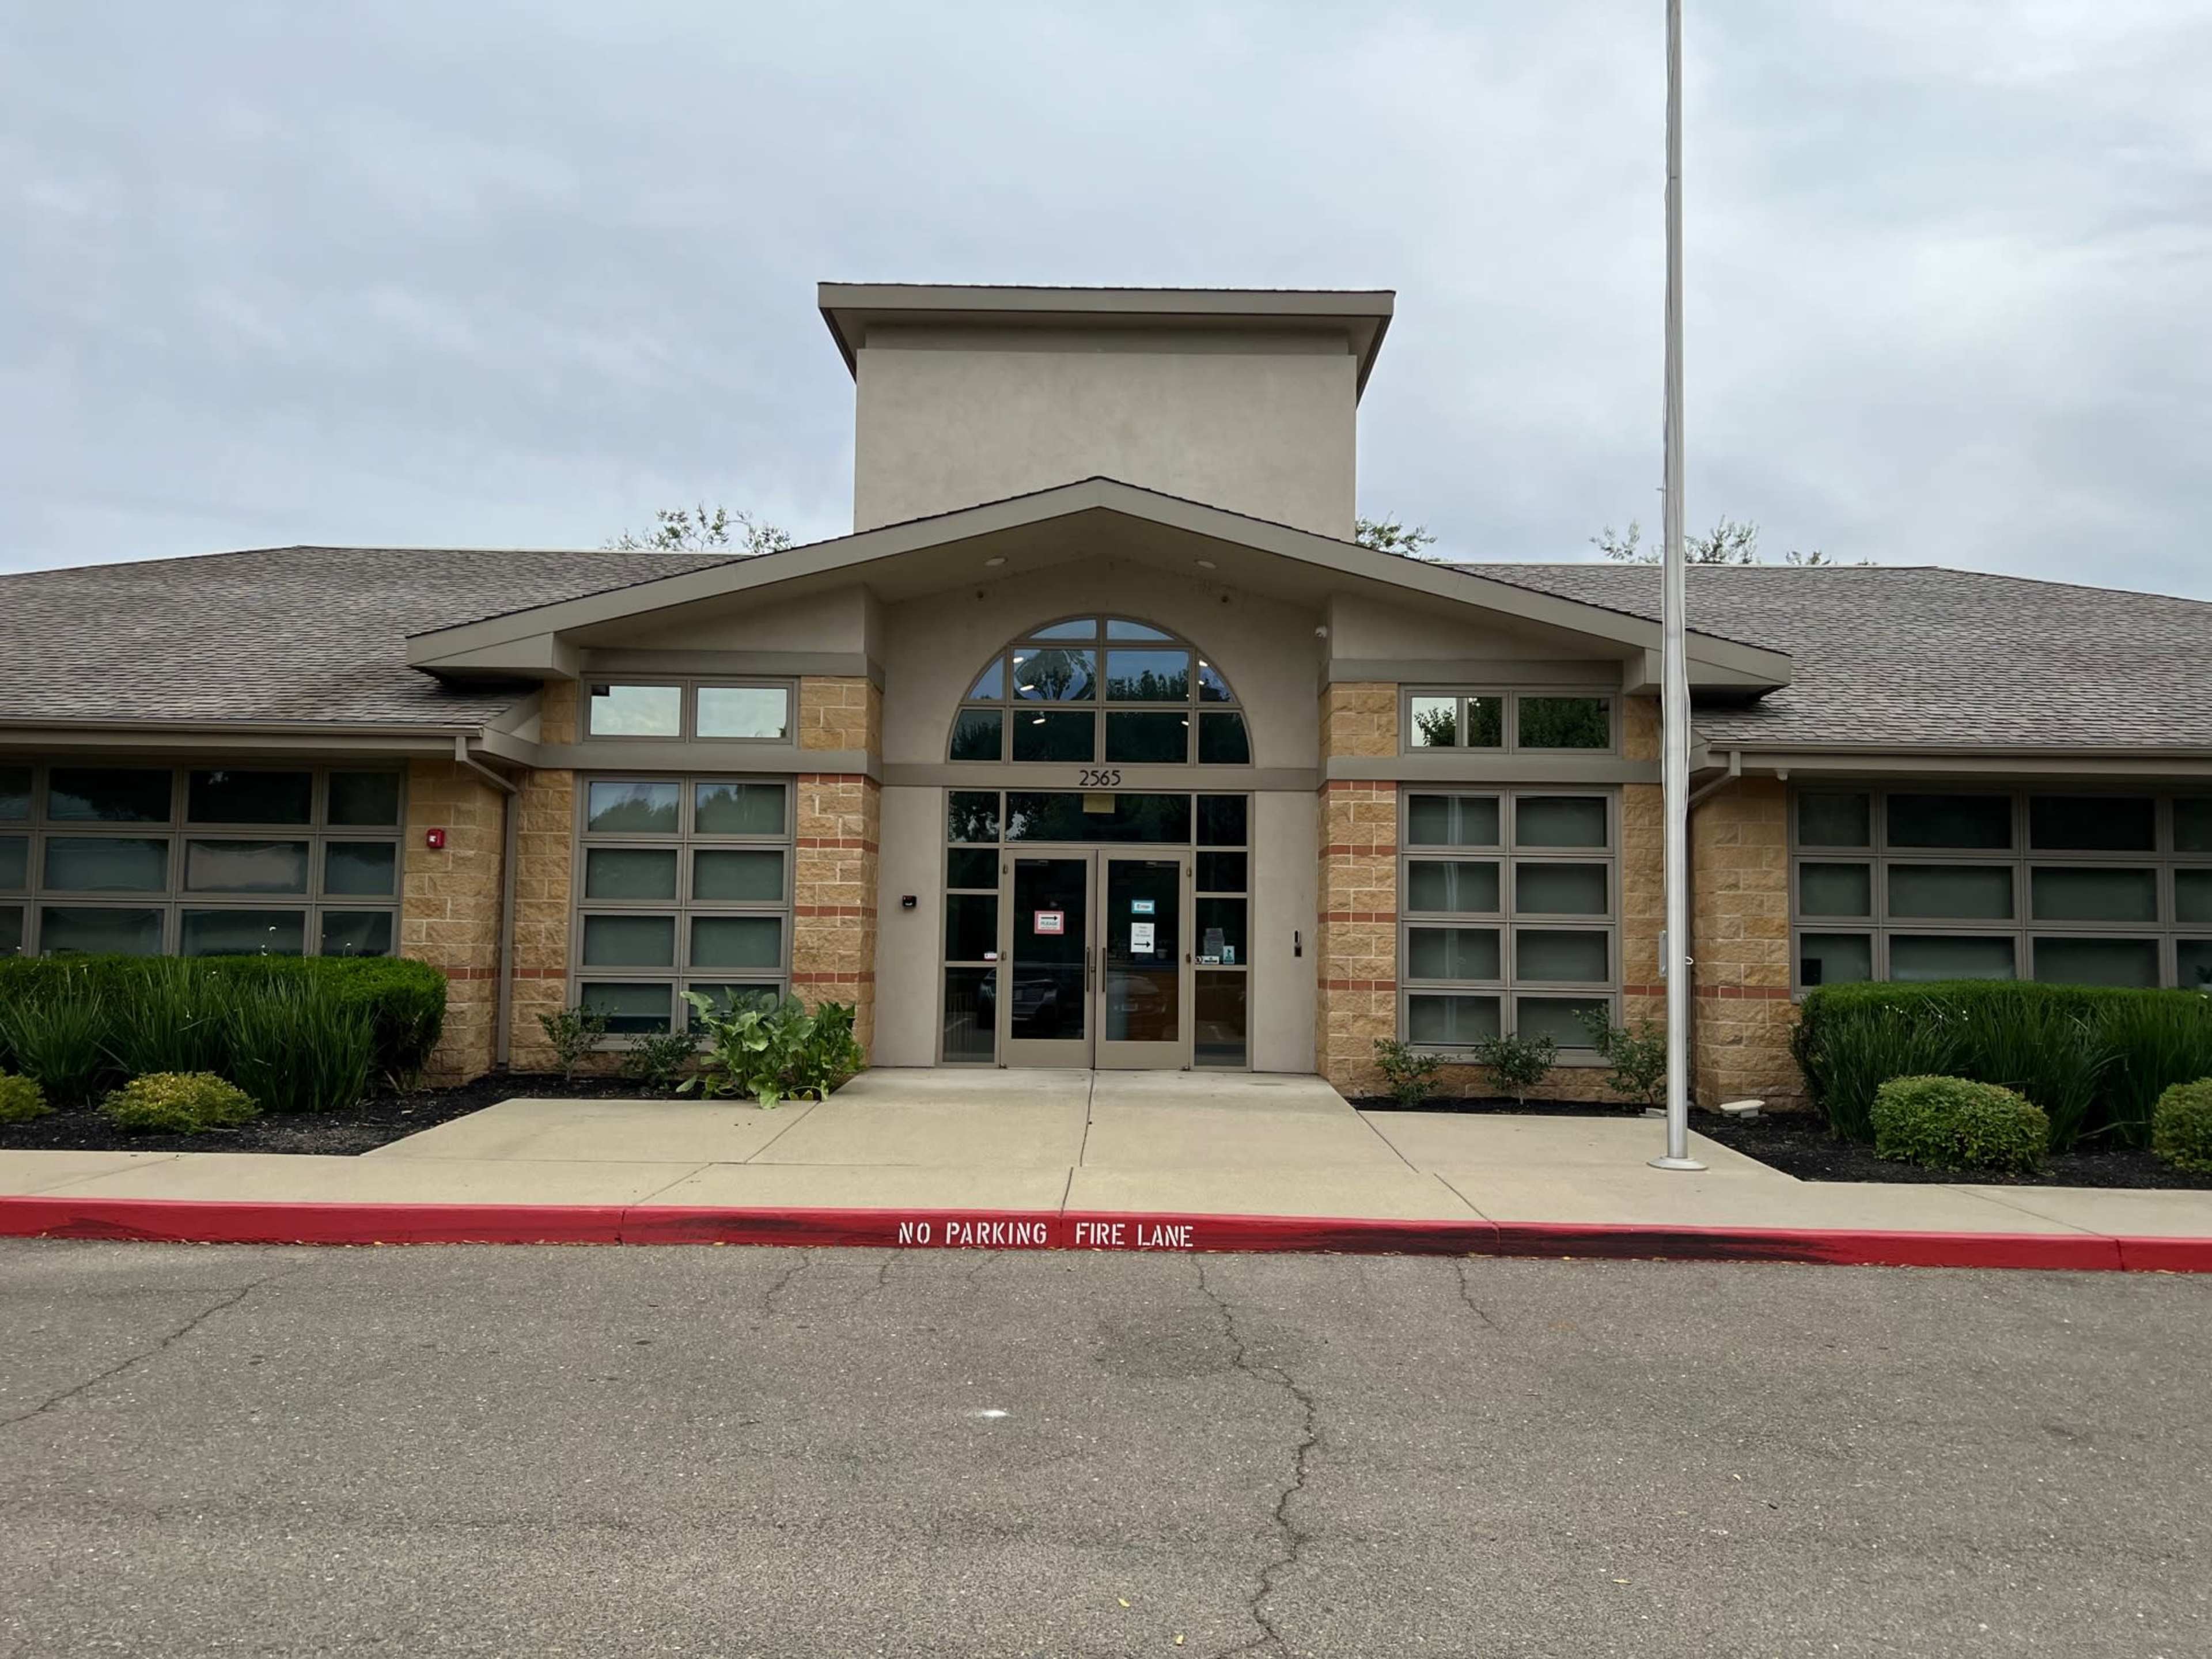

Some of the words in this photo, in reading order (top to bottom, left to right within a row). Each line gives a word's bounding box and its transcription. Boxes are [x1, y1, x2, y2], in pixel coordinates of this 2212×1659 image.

[1079, 770, 1120, 786] 2565
[899, 1222, 930, 1244] NO
[946, 1222, 1047, 1245] PARKING
[1075, 1222, 1126, 1245] FIRE
[1137, 1224, 1194, 1247] LANE
